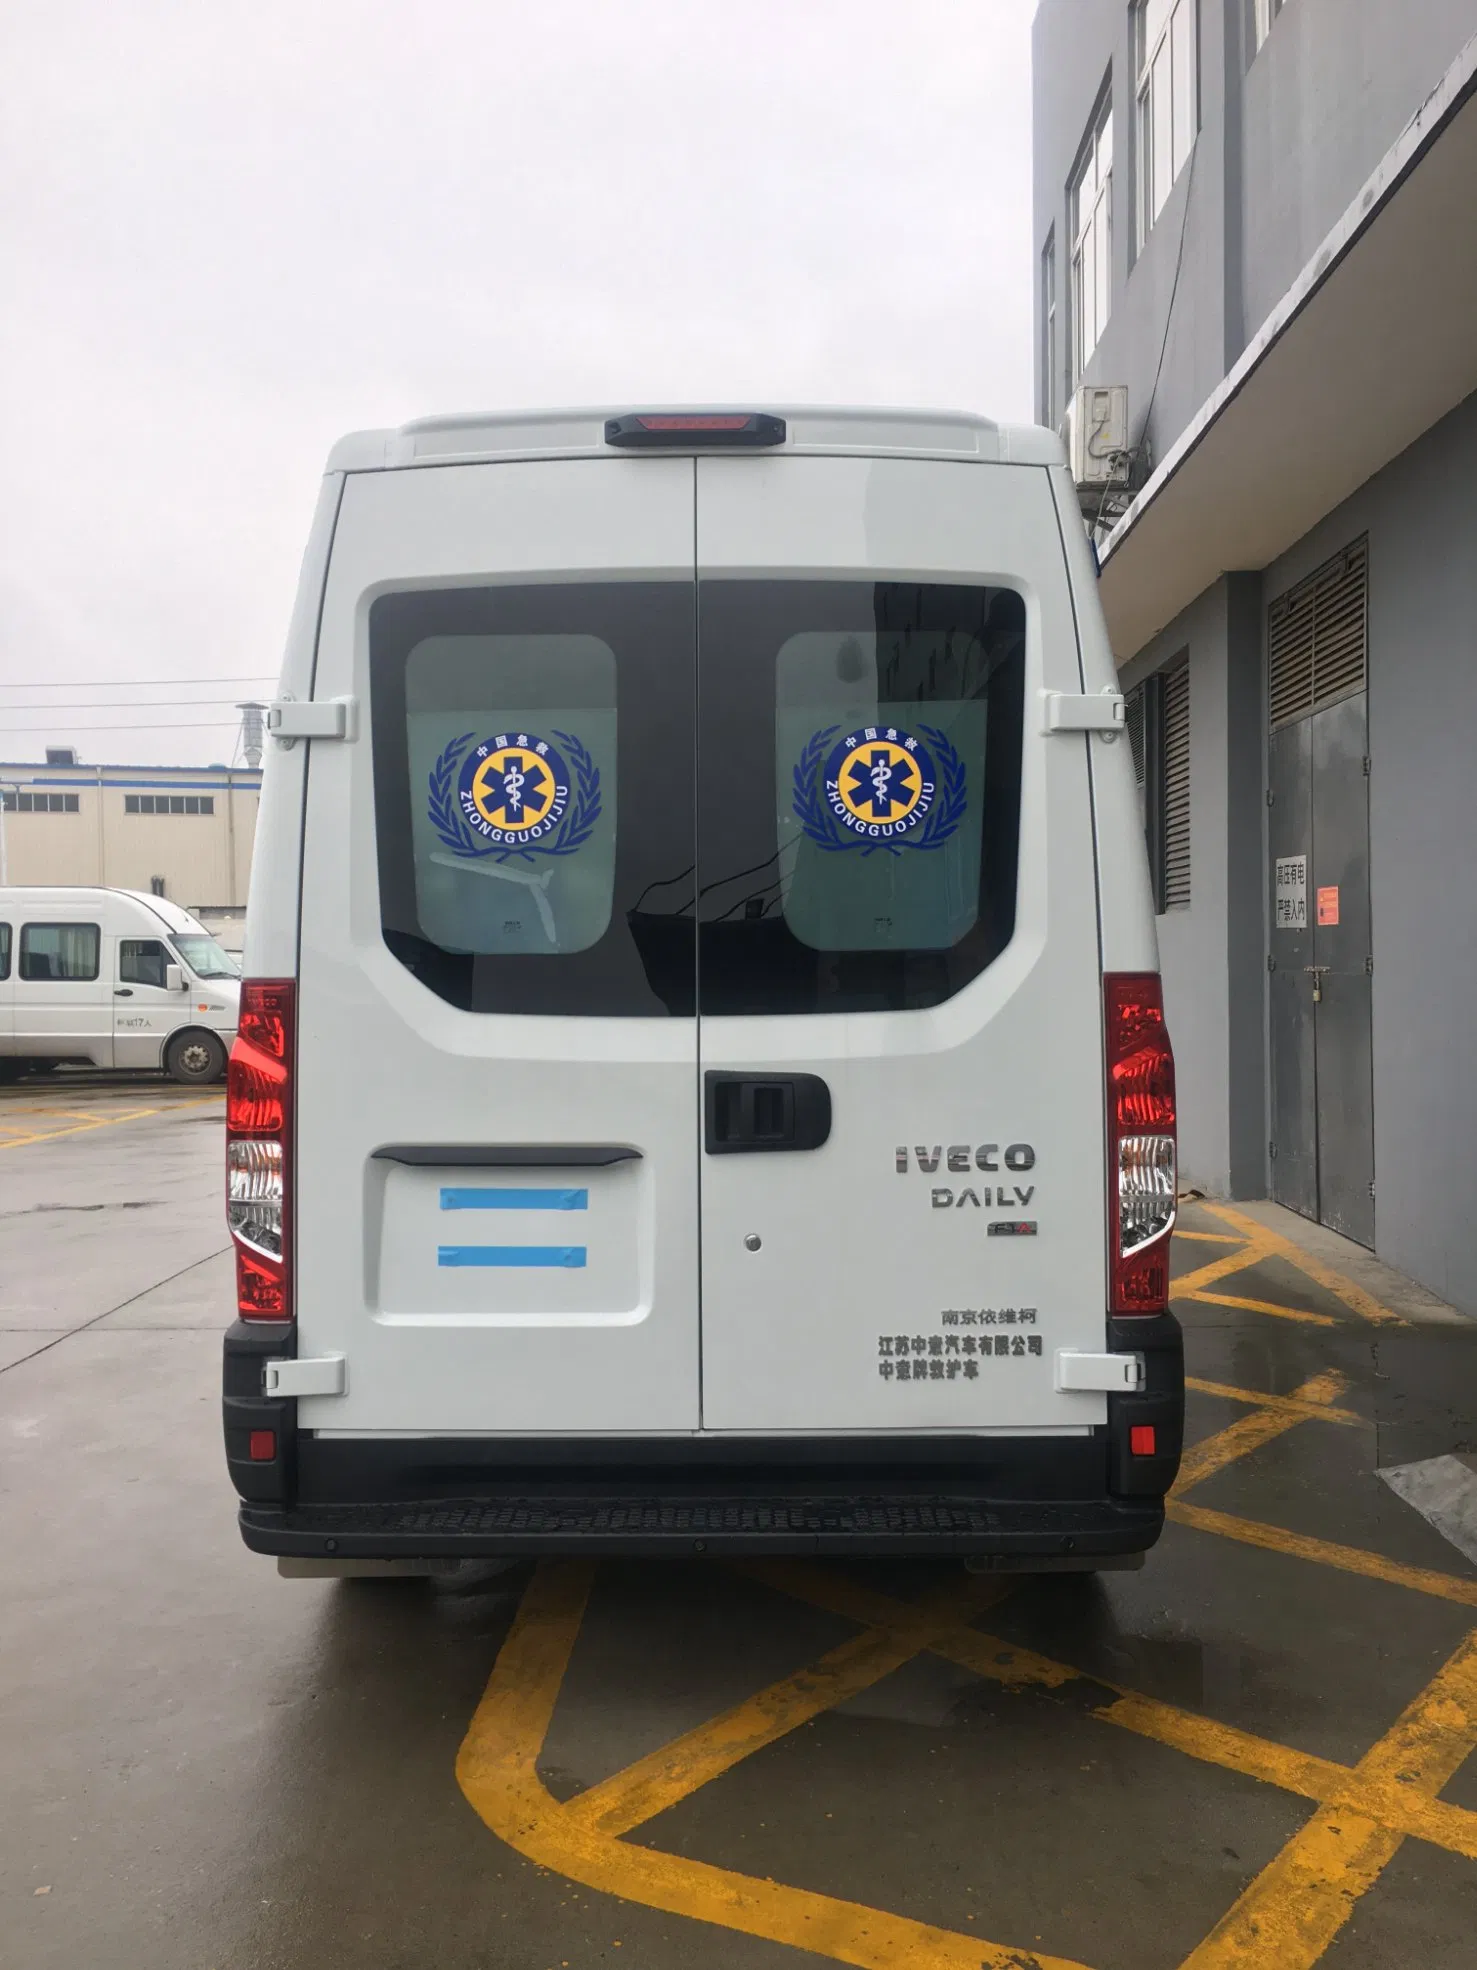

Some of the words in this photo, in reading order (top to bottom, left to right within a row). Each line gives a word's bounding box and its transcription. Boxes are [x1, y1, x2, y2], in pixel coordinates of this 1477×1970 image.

[477, 734, 549, 758] 中国急救
[845, 727, 918, 751] 中国急救
[460, 785, 568, 844] ZHONGGUOJIJIU
[827, 780, 935, 837] ZHONGGUOJIJIU
[895, 1143, 1036, 1173] IVECO
[931, 1185, 1035, 1208] DAILY
[940, 1307, 1037, 1326] 南京依维柯
[878, 1334, 1043, 1356] 江苏中意汽车有限公司
[878, 1358, 980, 1381] 中意牌救护车
